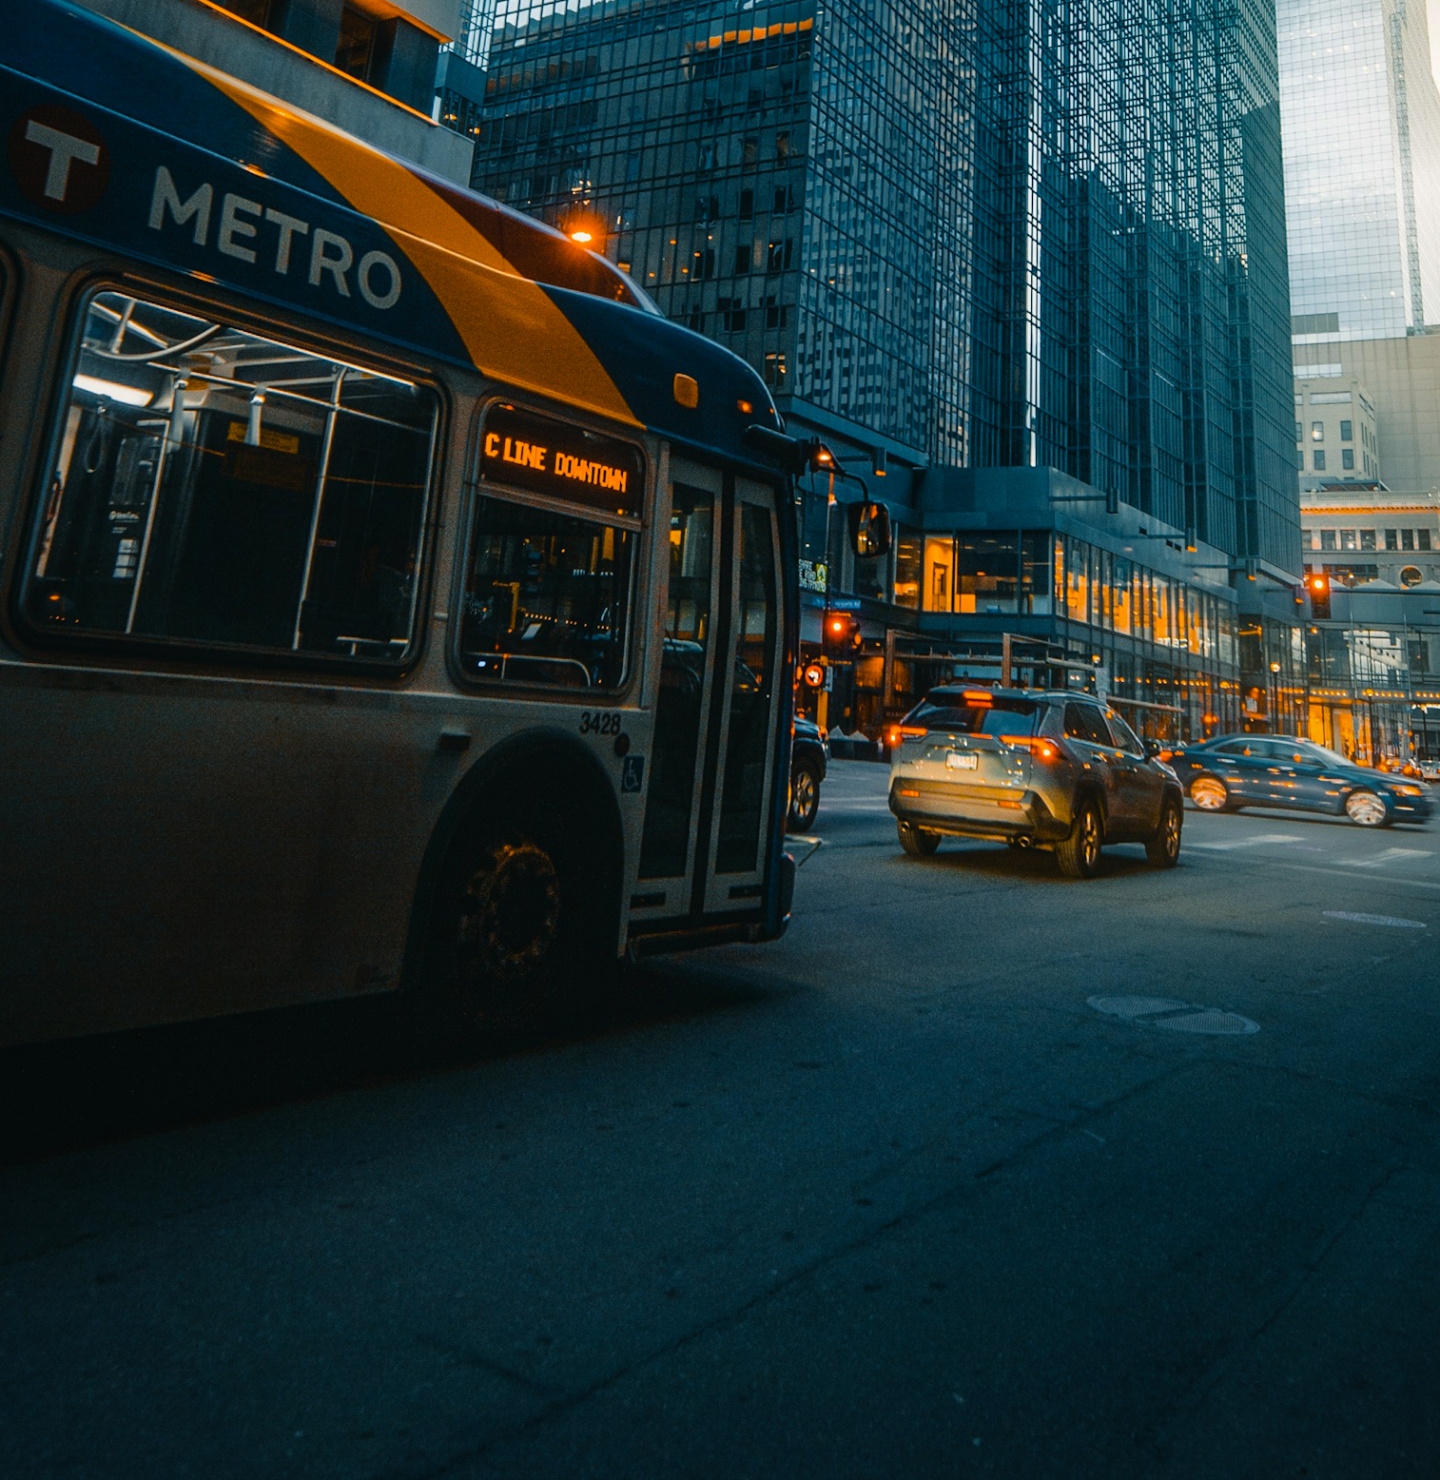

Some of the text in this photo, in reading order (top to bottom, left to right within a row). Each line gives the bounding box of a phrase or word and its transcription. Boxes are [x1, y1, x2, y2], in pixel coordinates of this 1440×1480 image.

[25, 120, 99, 201] T
[147, 165, 401, 309] METRO
[484, 433, 627, 493] C LINE DOWNTOWN
[580, 711, 621, 735] 3428
